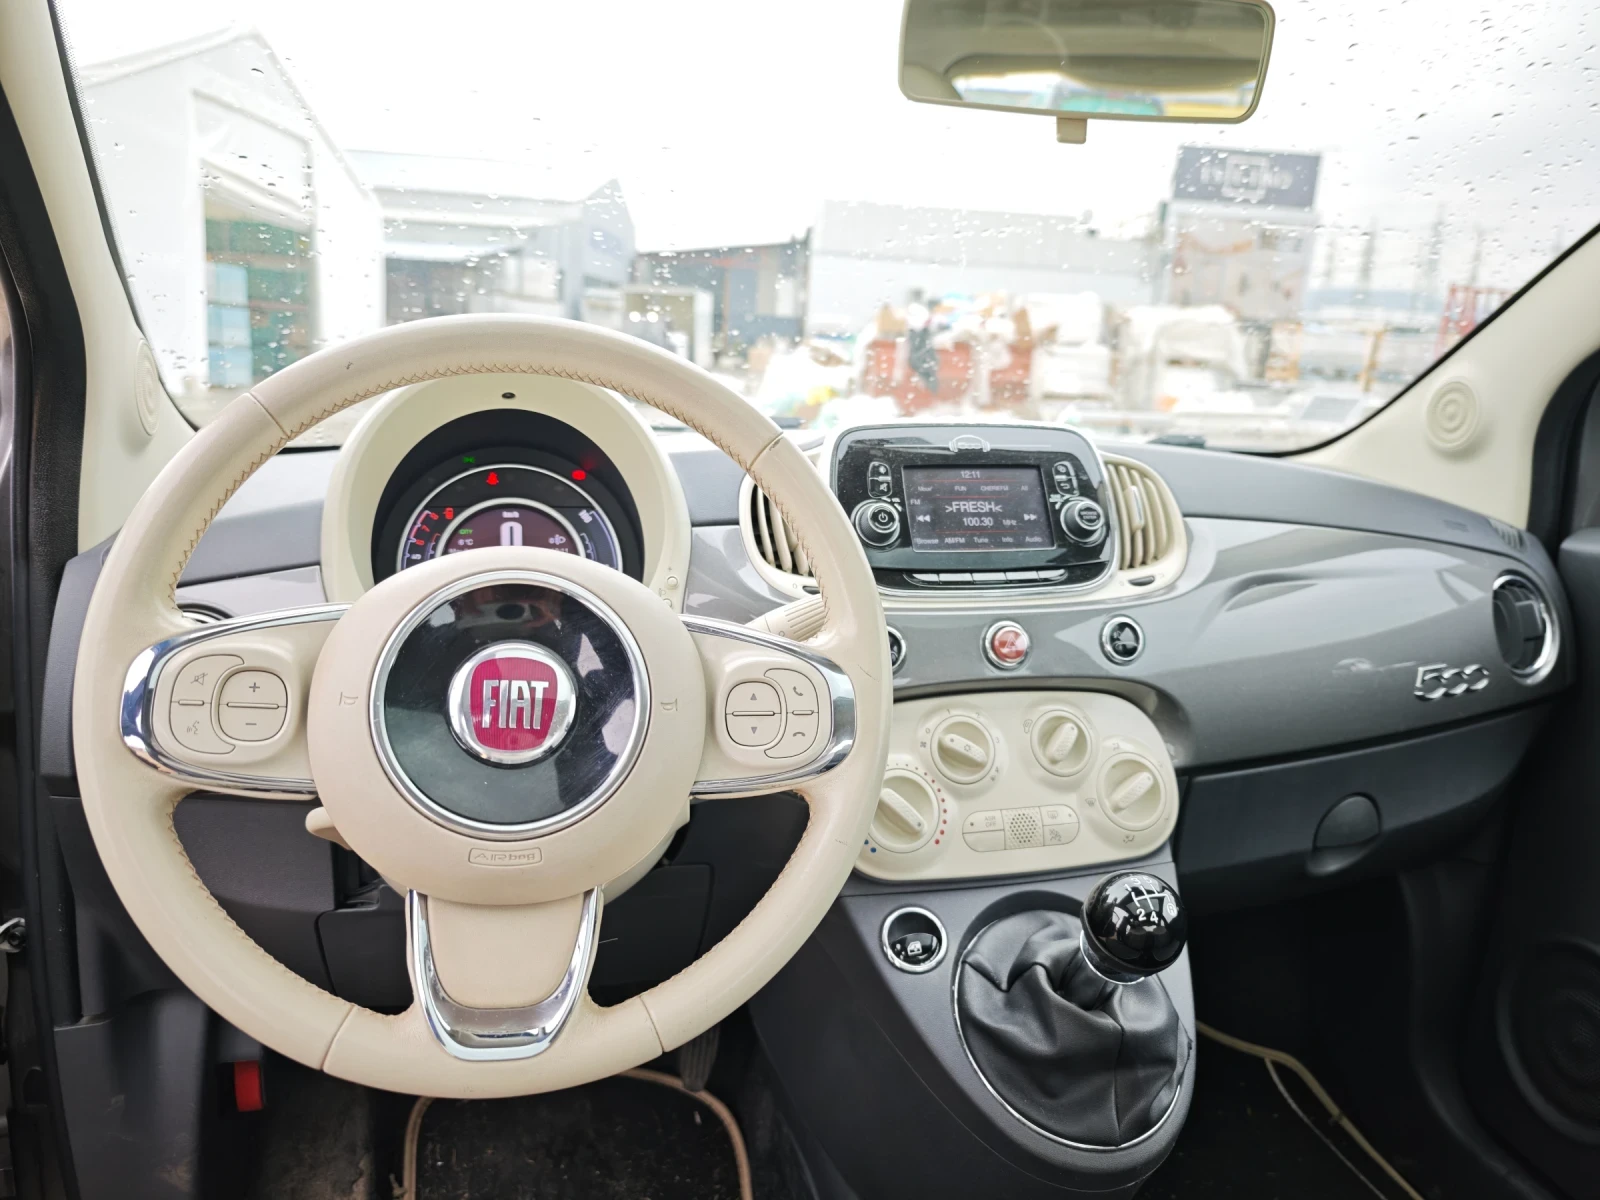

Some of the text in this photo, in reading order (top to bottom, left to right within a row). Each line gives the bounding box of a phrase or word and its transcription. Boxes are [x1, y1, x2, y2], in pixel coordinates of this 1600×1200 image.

[960, 470, 981, 479] 12:11
[945, 501, 1002, 513] >FRESH<
[962, 517, 993, 527] 100.30
[1413, 663, 1490, 699] 500
[481, 679, 549, 730] FIAT
[1131, 877, 1142, 886] 3
[1137, 908, 1147, 921] 2
[1150, 911, 1159, 923] 4
